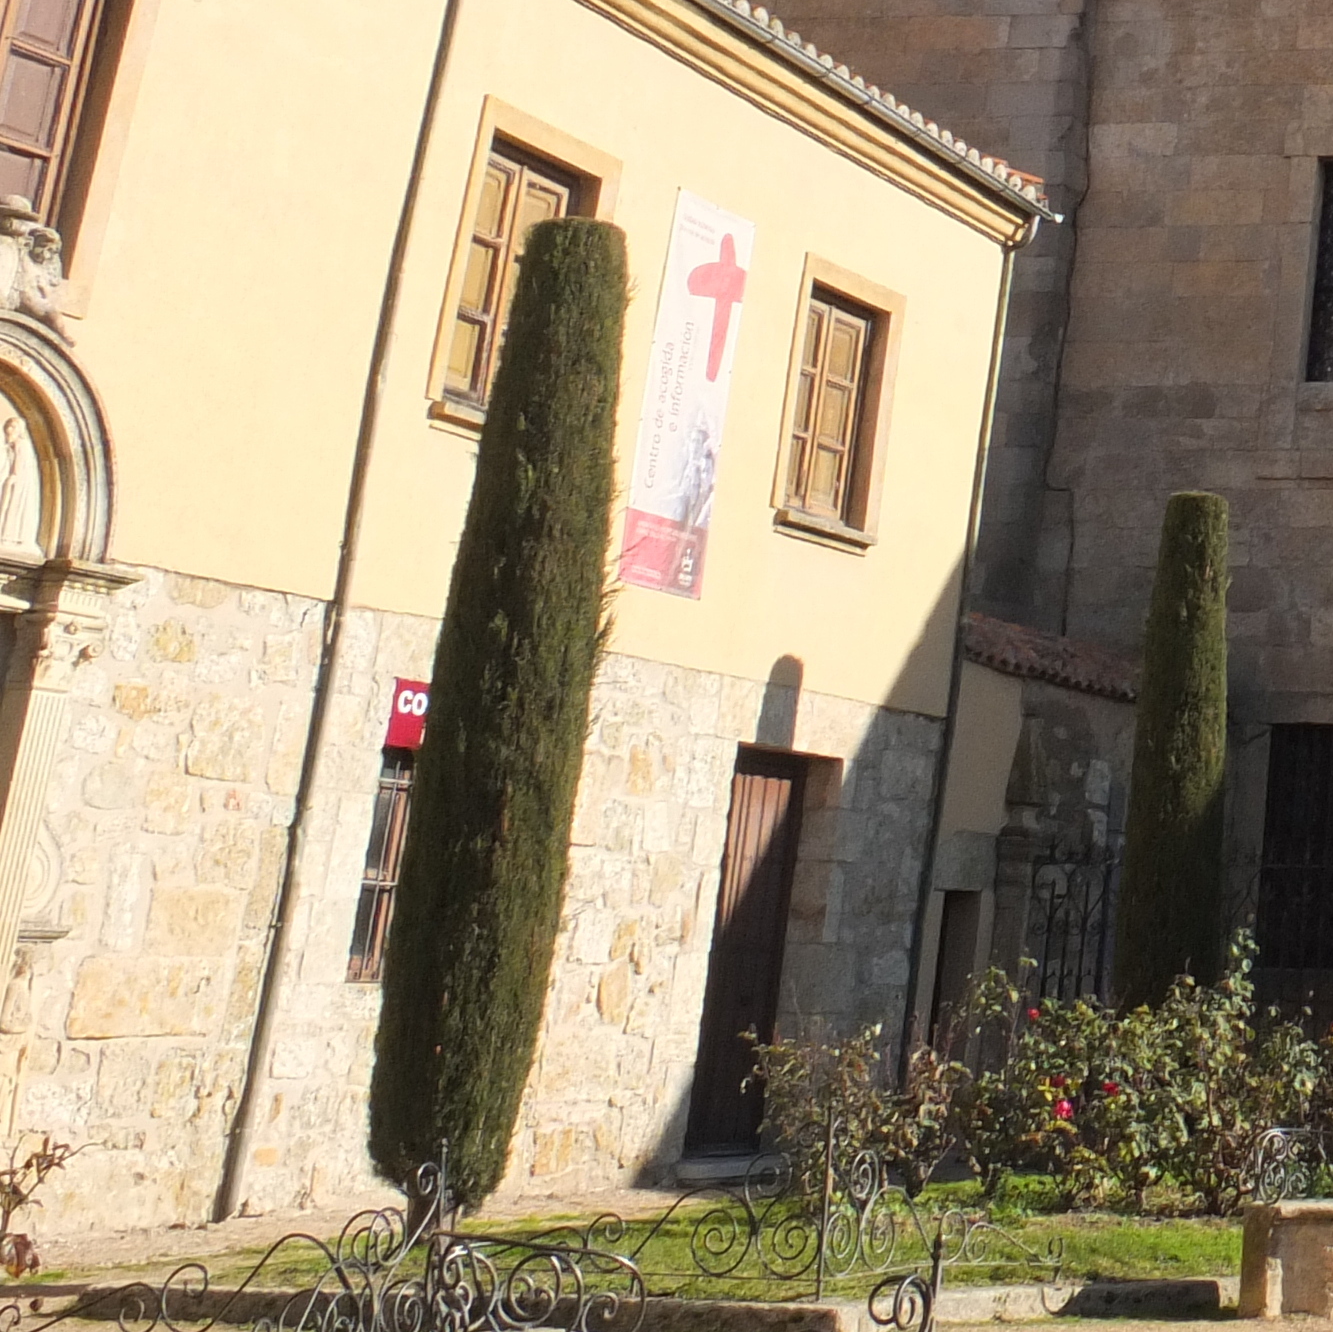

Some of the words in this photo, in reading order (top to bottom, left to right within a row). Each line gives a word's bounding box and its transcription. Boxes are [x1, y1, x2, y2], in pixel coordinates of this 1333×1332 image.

[658, 341, 675, 404] acogida
[668, 321, 695, 416] información
[655, 409, 665, 429] de
[644, 433, 662, 489] Centro
[397, 689, 429, 716] CO
